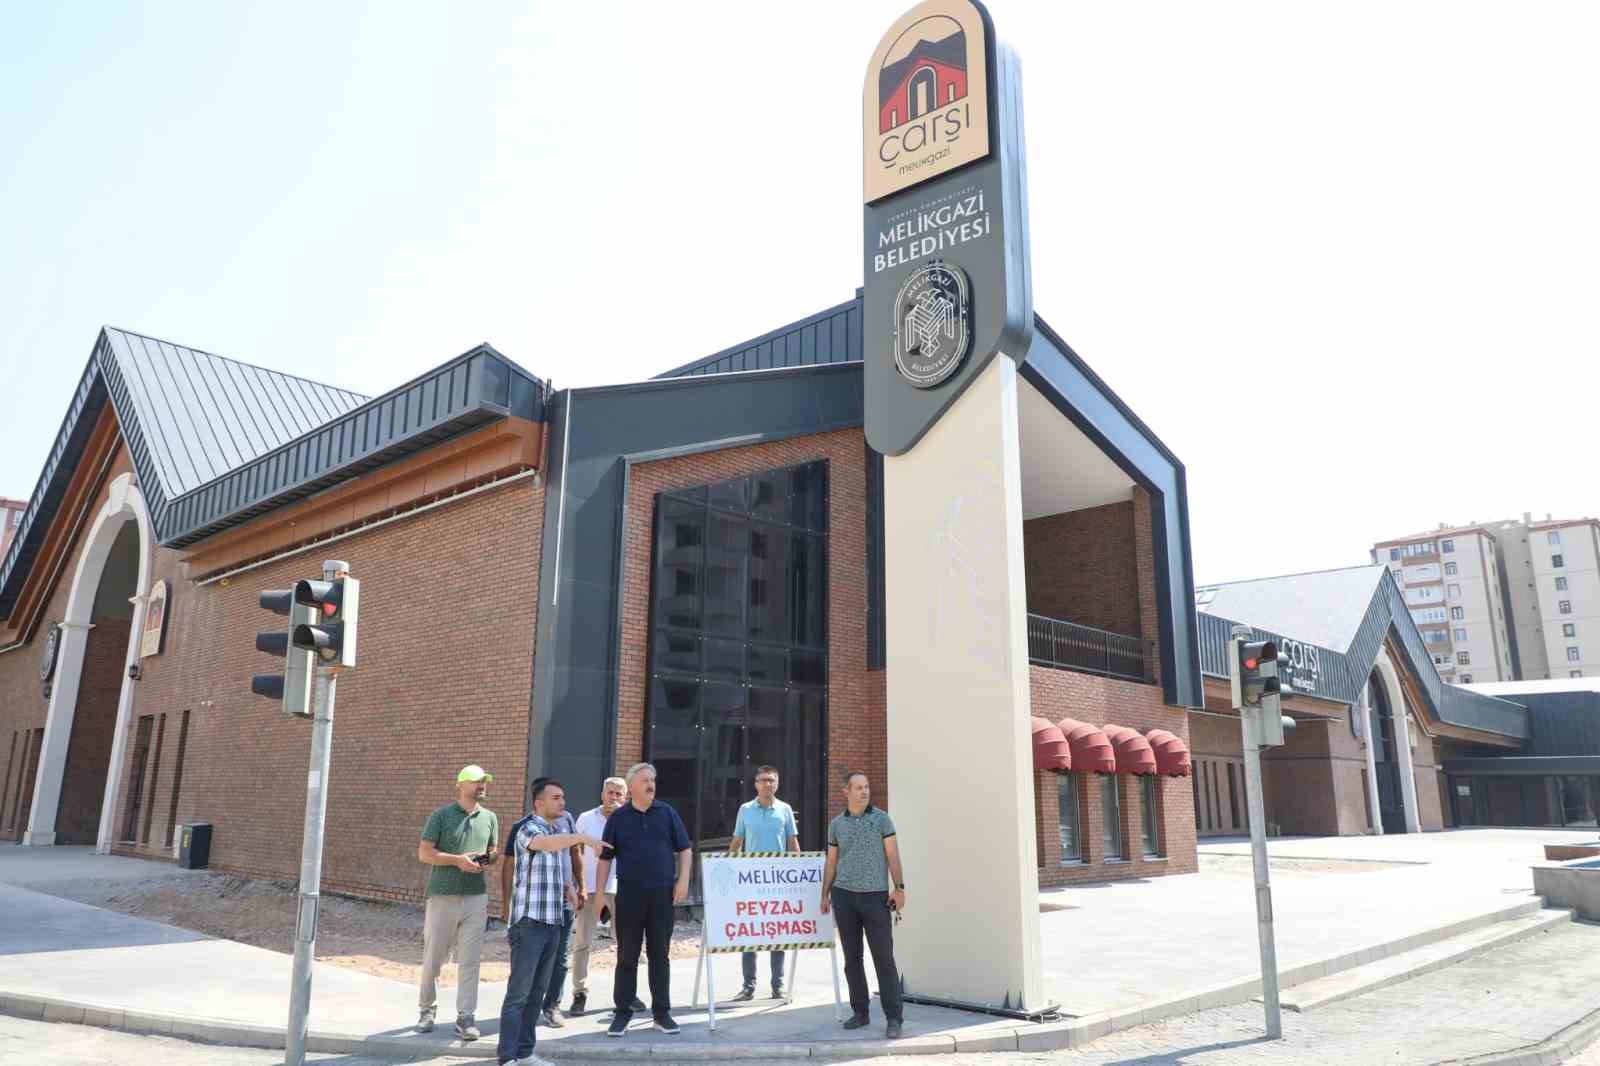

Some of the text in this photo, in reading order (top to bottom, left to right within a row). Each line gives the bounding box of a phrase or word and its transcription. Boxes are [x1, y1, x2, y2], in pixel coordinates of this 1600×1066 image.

[879, 103, 970, 169] çarşı
[879, 189, 984, 248] MELİKGAZİ
[874, 212, 990, 273] BELEDİYESİ
[738, 866, 823, 885] MELİKGAZİ
[735, 899, 803, 916] PEYZAJ
[725, 920, 817, 941] ÇALIŞMASI
